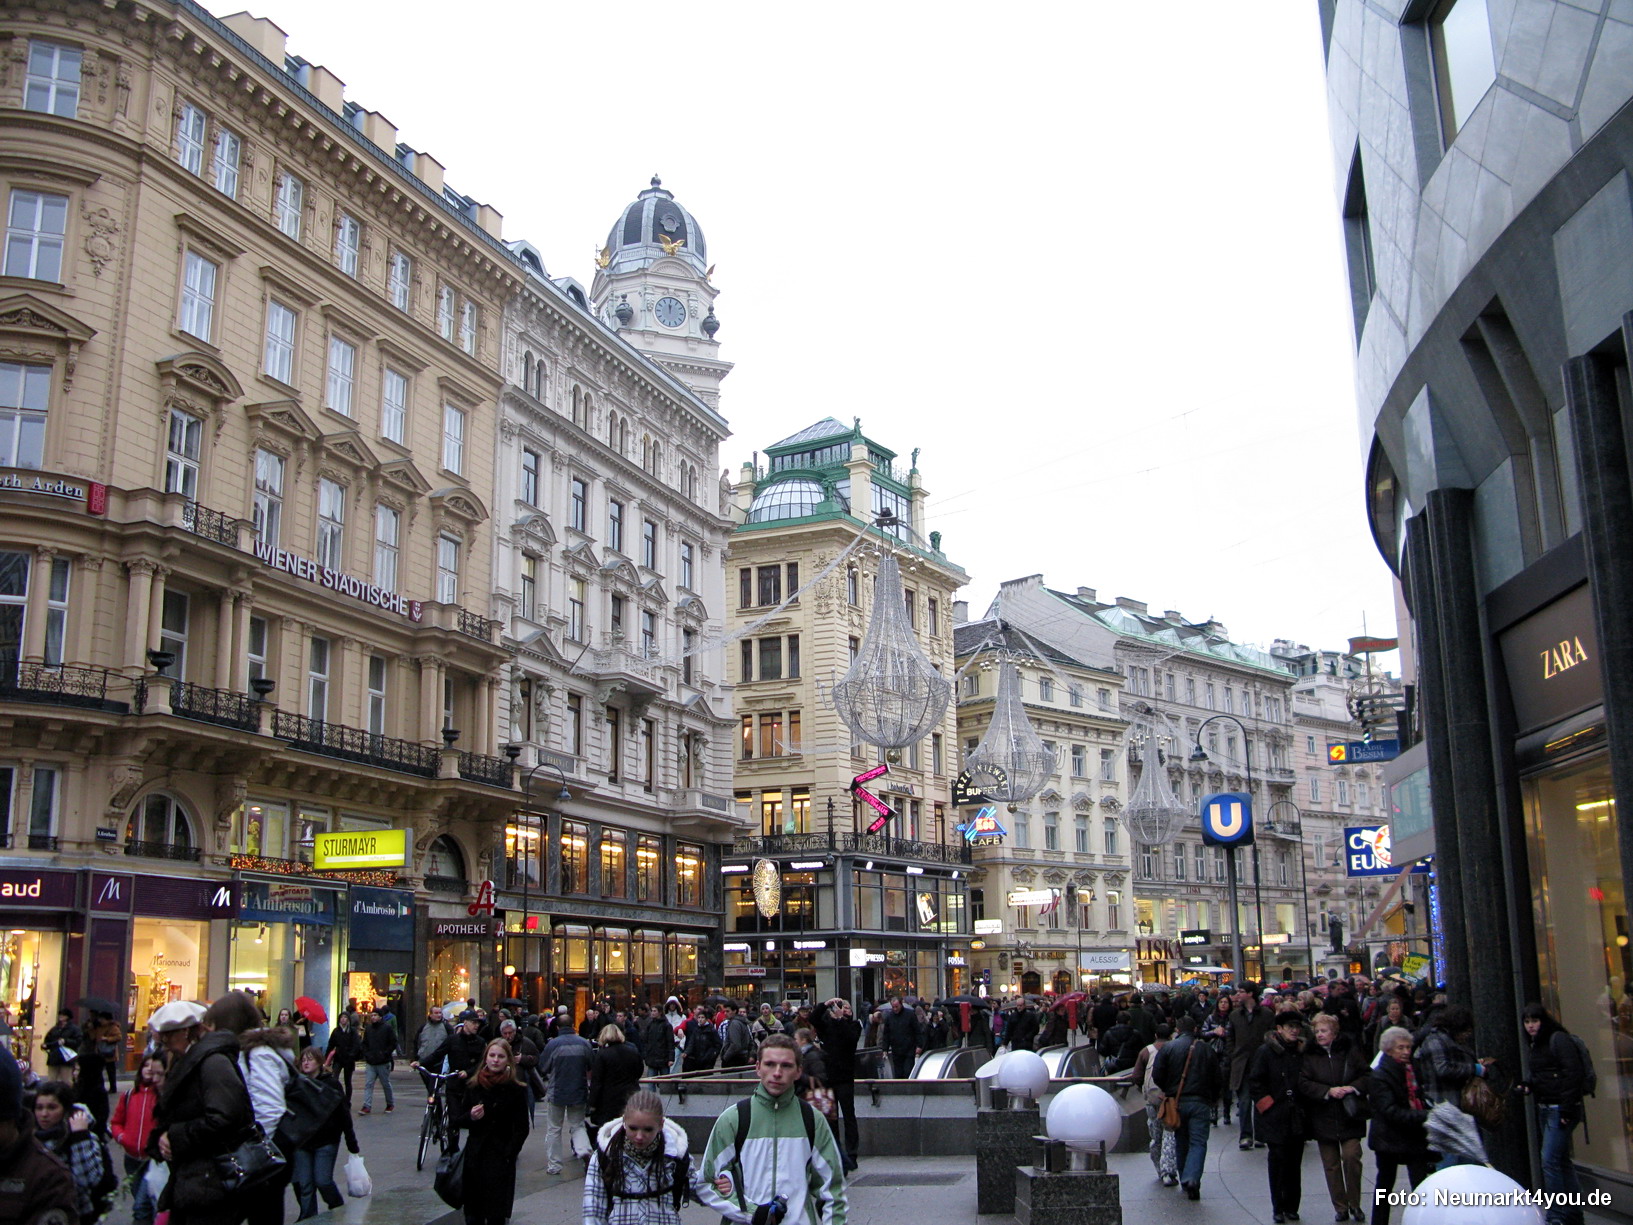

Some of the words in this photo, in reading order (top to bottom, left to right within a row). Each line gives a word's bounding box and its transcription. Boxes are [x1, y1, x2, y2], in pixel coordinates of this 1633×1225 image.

[0, 473, 21, 488] th
[32, 476, 84, 497] Arden
[255, 541, 317, 582] WIENER
[322, 567, 409, 616] STÄDTISCHE
[1540, 636, 1588, 679] ZARA
[1209, 802, 1242, 837] U
[323, 837, 377, 856] STURMAYR
[1, 878, 41, 897] aud
[353, 900, 396, 916] d'Ambrosio
[437, 924, 487, 934] APOTHEKE
[1135, 939, 1184, 960] LISKA
[947, 956, 965, 965] FOSSIL
